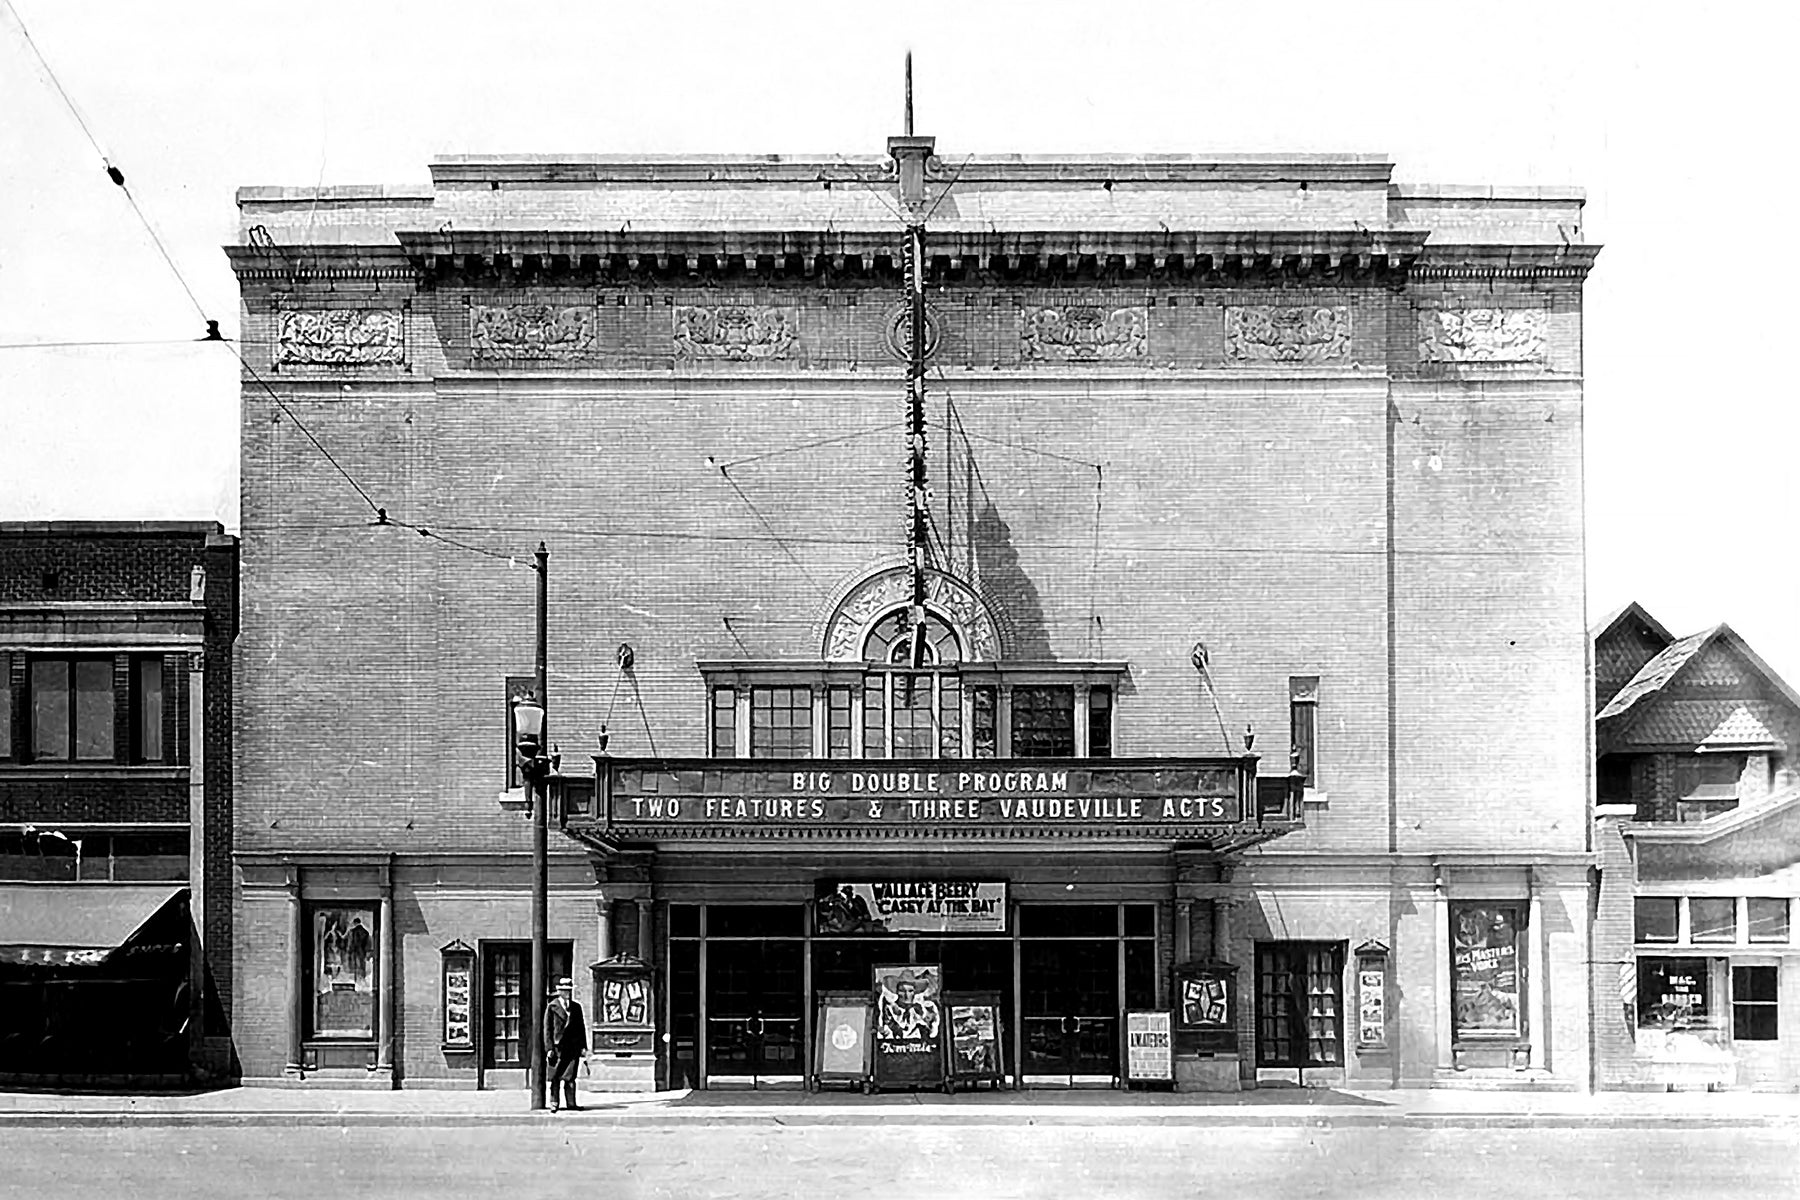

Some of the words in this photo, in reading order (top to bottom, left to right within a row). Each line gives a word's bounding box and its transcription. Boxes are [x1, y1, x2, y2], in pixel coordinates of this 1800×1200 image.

[792, 771, 831, 792] BIG
[852, 772, 938, 792] DOUBLE
[958, 772, 1068, 792] PROGRAM
[632, 798, 680, 818] TWO
[705, 798, 824, 818] FEATURES
[868, 799, 882, 818] &
[909, 799, 980, 818] THREE
[1000, 798, 1142, 818] VAUDEVILLE
[1162, 798, 1225, 817] ACTS
[873, 883, 933, 901] WALLACE
[936, 883, 979, 901] BEERY
[927, 901, 942, 913] AT
